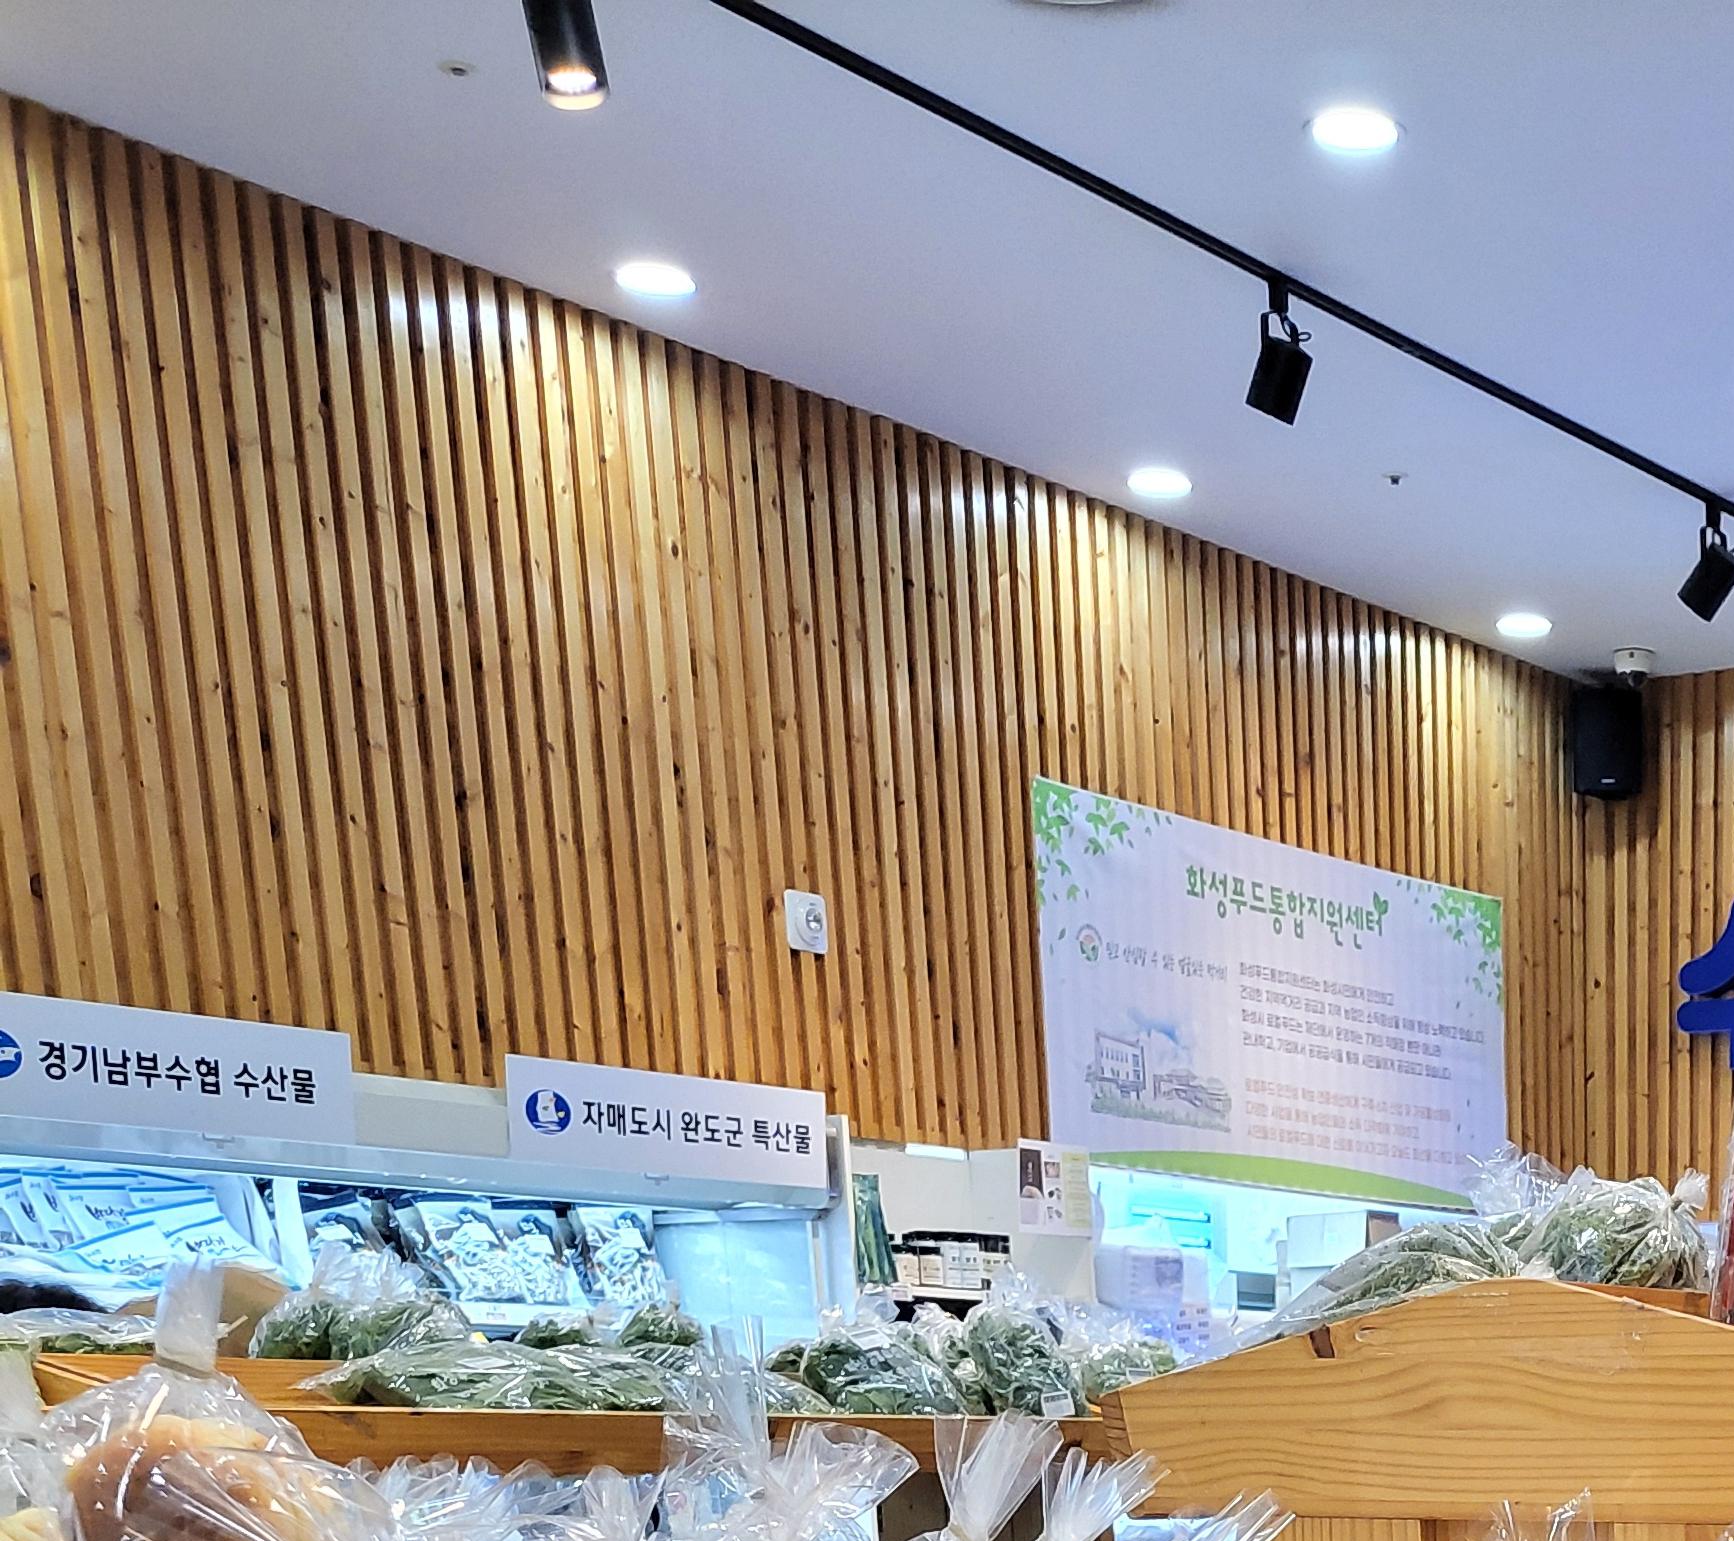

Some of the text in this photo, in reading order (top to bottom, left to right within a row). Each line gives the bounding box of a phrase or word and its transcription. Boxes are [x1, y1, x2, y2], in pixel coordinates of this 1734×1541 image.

[1186, 865, 1384, 949] 화성푸드통합지원센터
[37, 1039, 318, 1106] 경기남부수협 수산물
[581, 1099, 813, 1156] 자매도시 완도군 특산물
